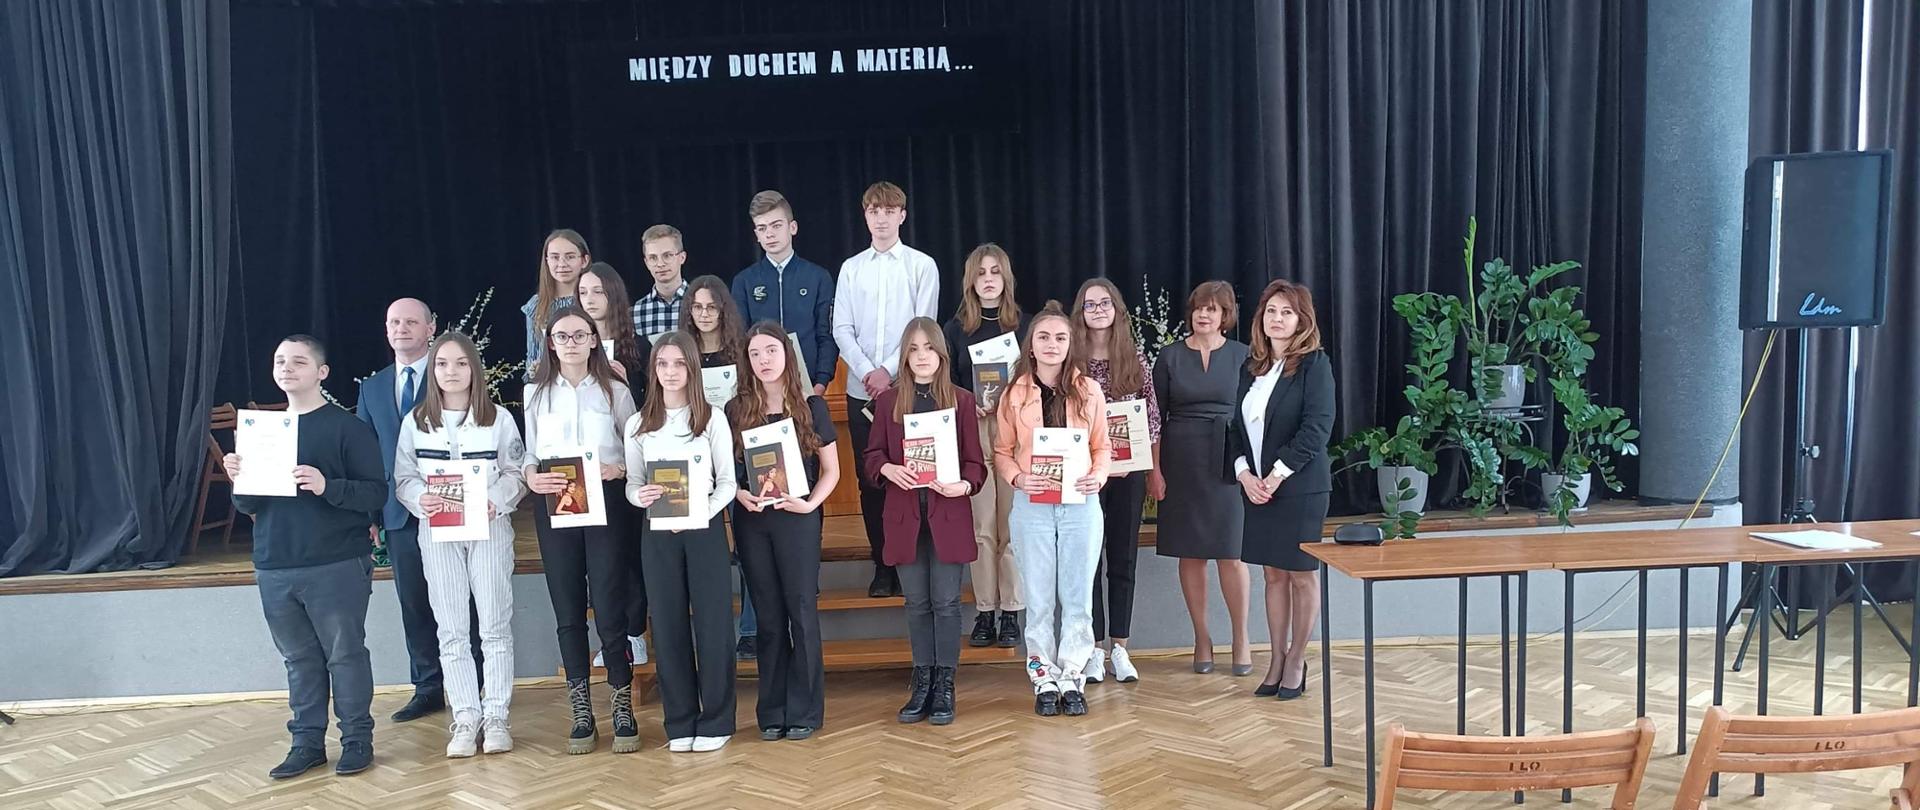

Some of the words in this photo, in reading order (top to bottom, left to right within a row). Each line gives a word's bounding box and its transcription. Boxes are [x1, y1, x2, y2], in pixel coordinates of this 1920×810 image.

[628, 55, 712, 83] MIĘDZY
[728, 52, 817, 78] DUCHEM
[830, 50, 844, 74] A
